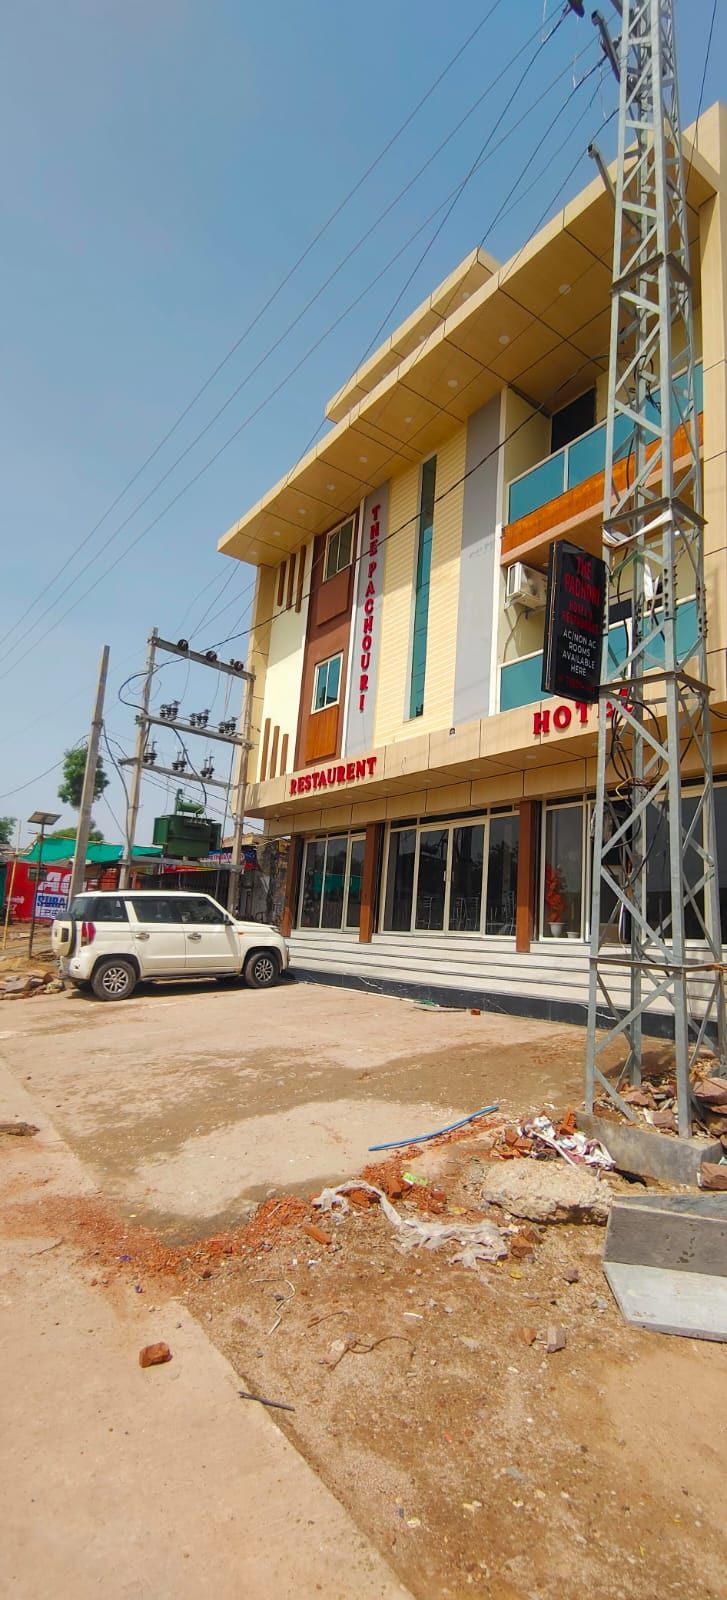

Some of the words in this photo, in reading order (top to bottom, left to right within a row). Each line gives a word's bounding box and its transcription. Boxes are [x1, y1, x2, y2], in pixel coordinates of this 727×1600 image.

[369, 504, 381, 556] THE
[359, 561, 377, 713] PACHOURI
[563, 628, 588, 645] AC/NON
[588, 639, 597, 649] AC
[562, 650, 596, 670] AVAILABLE
[569, 642, 591, 657] ROOMS
[570, 664, 587, 677] HERE
[289, 757, 377, 794] RESTAURENT
